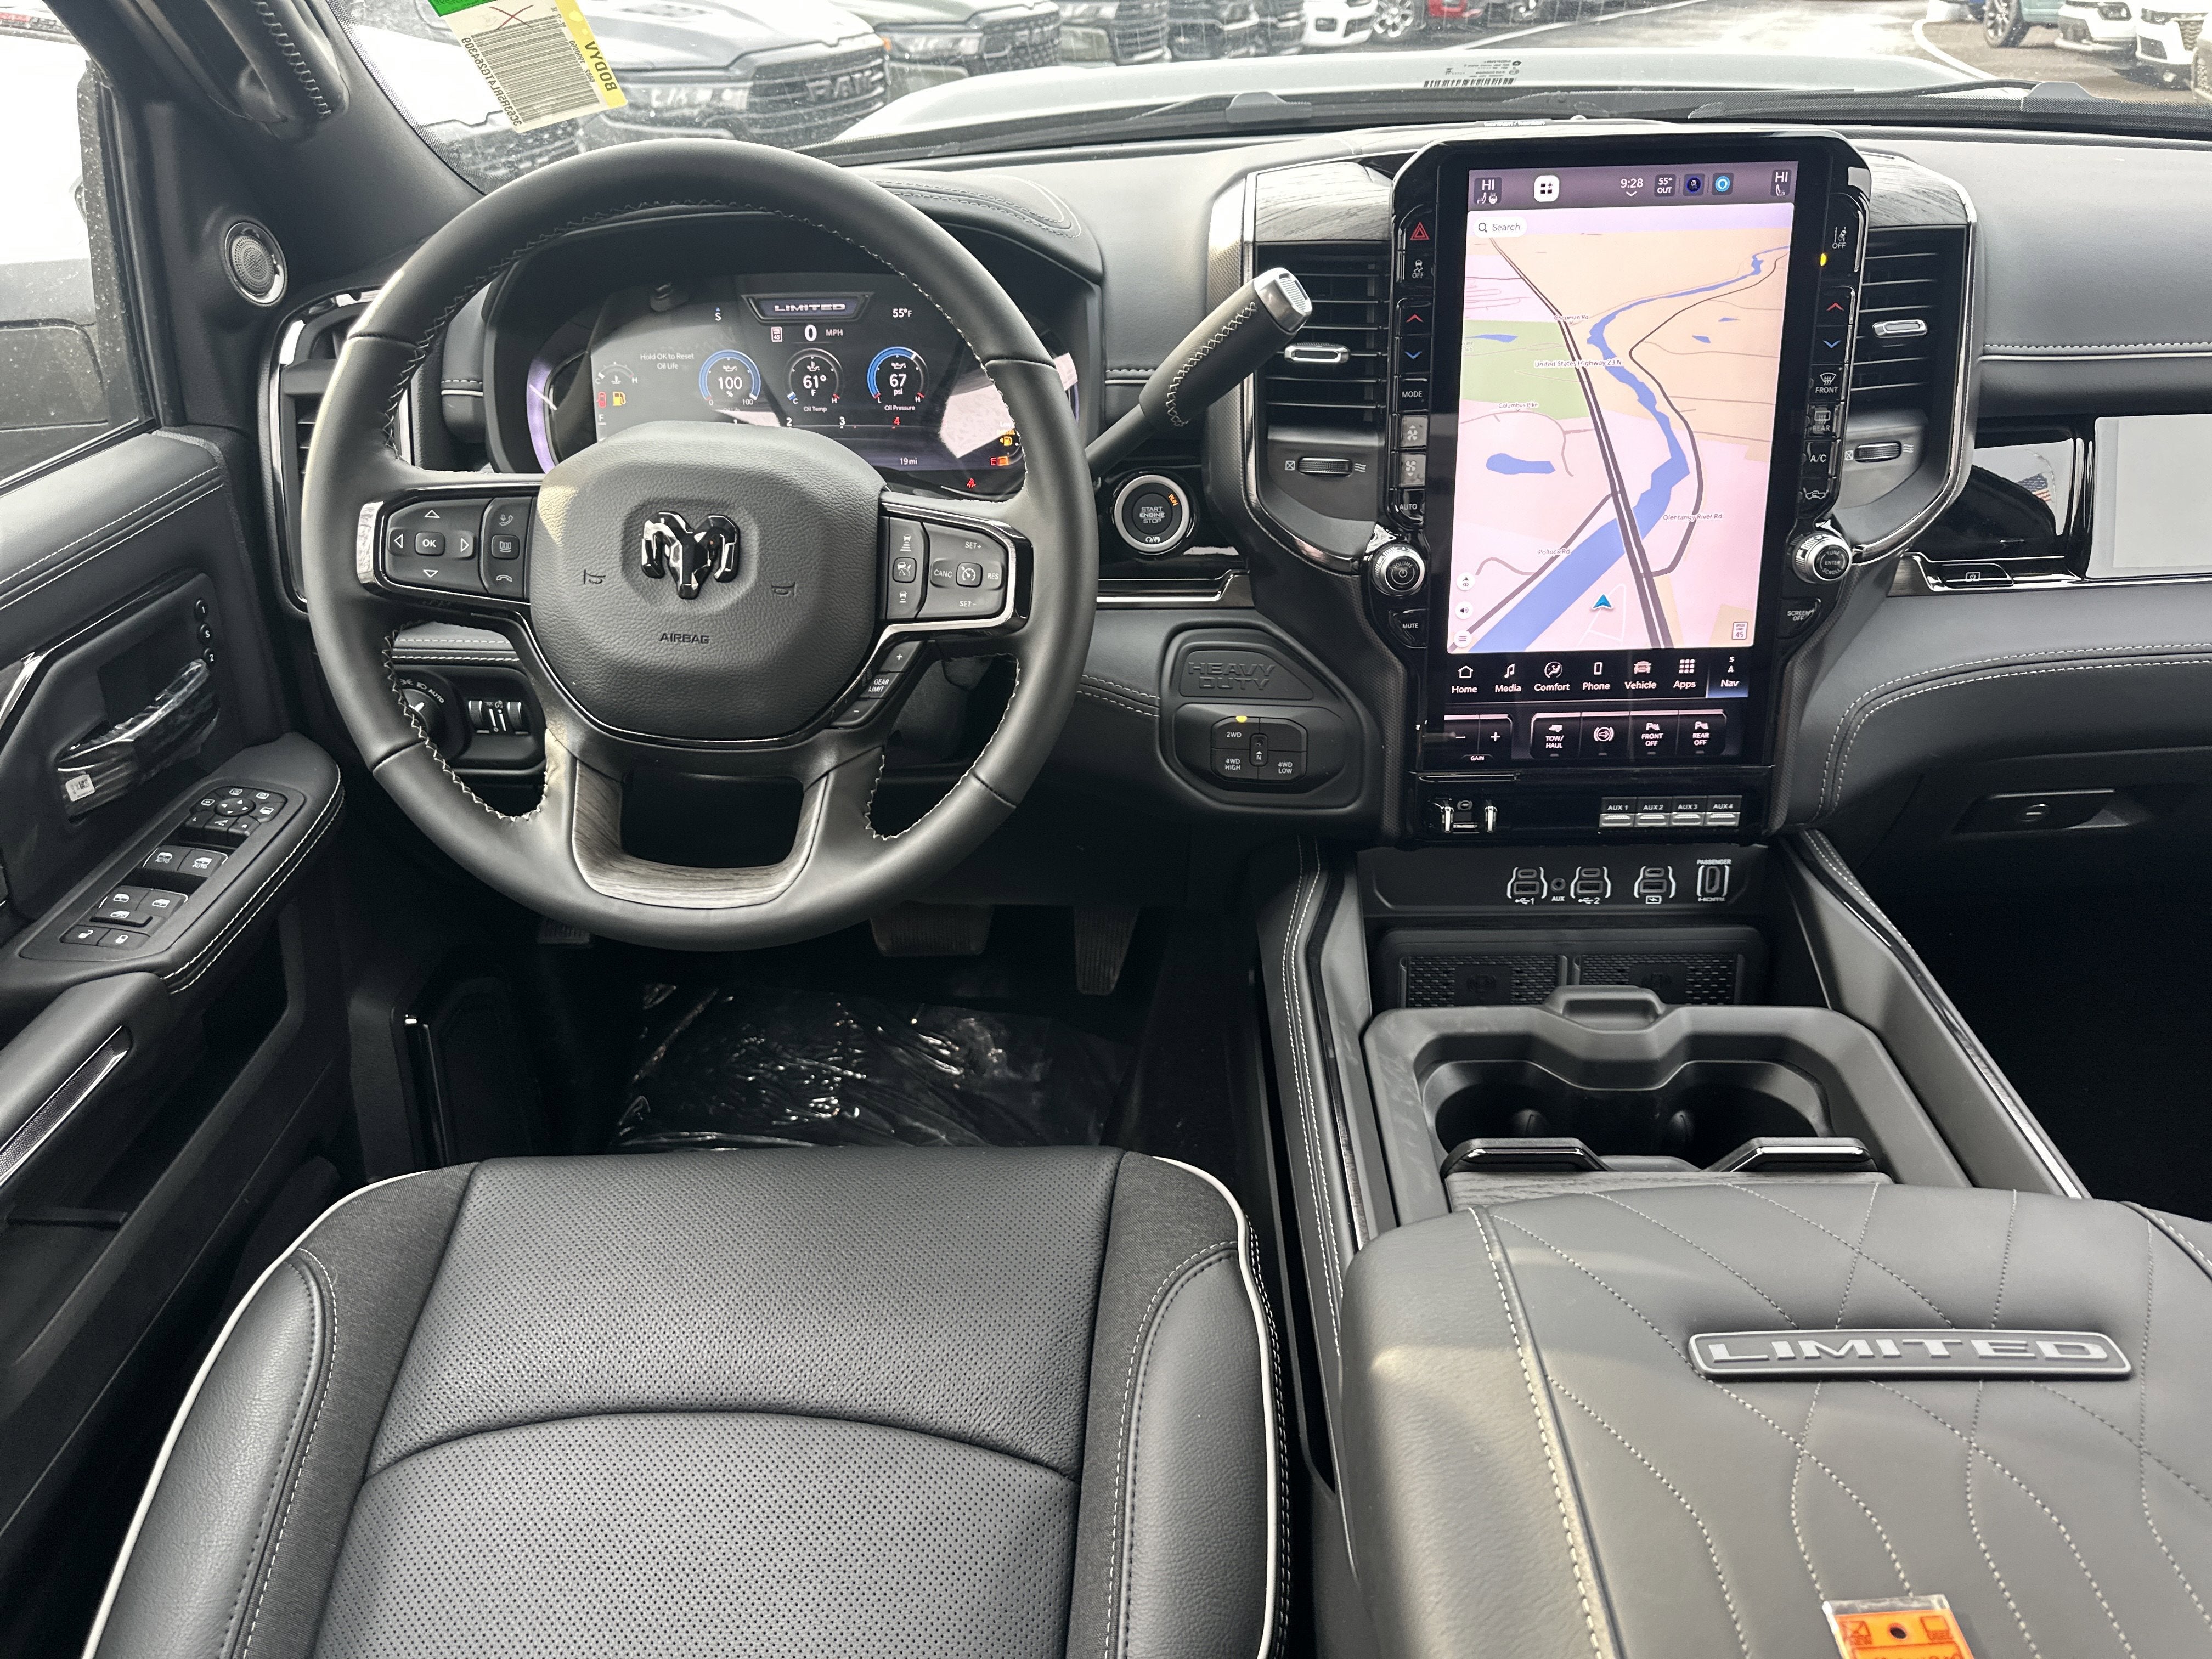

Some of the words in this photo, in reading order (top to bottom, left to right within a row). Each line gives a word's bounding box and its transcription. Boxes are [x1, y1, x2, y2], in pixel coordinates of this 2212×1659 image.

[1775, 171, 1788, 183] HI
[1482, 179, 1495, 190] HI
[1620, 178, 1644, 188] 9:28
[715, 312, 721, 321] S
[804, 324, 817, 342] 0
[718, 377, 743, 390] 100
[889, 374, 907, 387] 67
[893, 388, 903, 397] psi
[786, 417, 792, 426] 2
[839, 416, 845, 426] 3
[893, 416, 901, 426] 4
[990, 457, 996, 465] E
[1810, 454, 1827, 462] A/C
[422, 539, 437, 548] OK
[1392, 561, 1413, 569] VOLUME
[934, 569, 952, 578] CANC
[659, 633, 710, 644] AIRBAG
[210, 653, 214, 662] 2
[1188, 662, 1276, 676] HEAVY
[1199, 676, 1270, 690] DUTY
[1495, 684, 1521, 692] Media
[1534, 682, 1570, 692] Comfort
[1582, 682, 1611, 690] Phone
[1624, 680, 1657, 689] Vehicle
[1673, 680, 1696, 690] Apps
[1451, 685, 1477, 693] Home
[428, 689, 444, 703] AUTO
[1708, 1338, 2108, 1362] LIMITED
